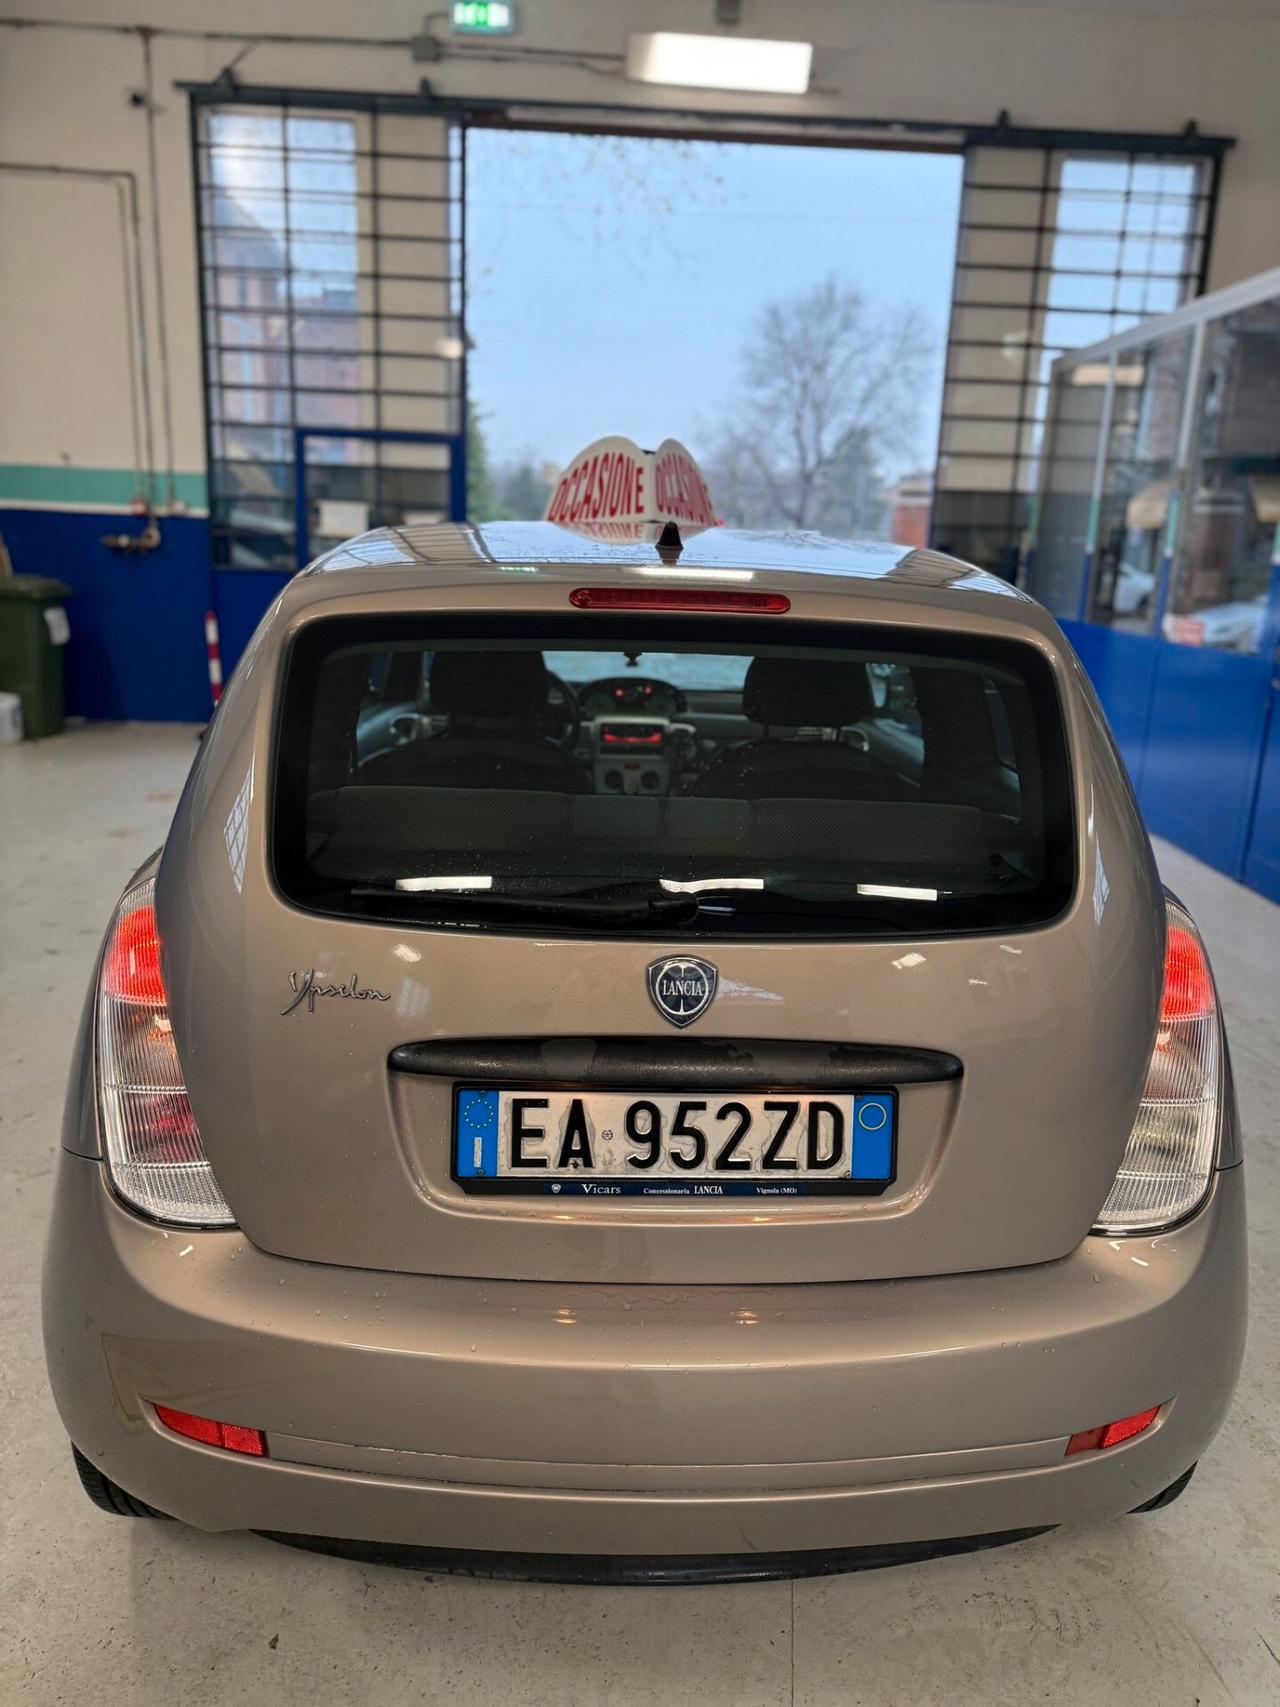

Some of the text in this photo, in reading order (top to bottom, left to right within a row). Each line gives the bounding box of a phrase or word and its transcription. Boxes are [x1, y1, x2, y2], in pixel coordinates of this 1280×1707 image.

[546, 452, 644, 521] OCCASIONE
[280, 968, 392, 1016] Ypsilon
[662, 979, 704, 996] LANCIA
[511, 1098, 846, 1170] EA 952ZD
[581, 1183, 622, 1194] Vicars
[643, 1187, 690, 1195] Concessionaria
[694, 1185, 723, 1195] LANCIA
[756, 1187, 780, 1196] Vignola
